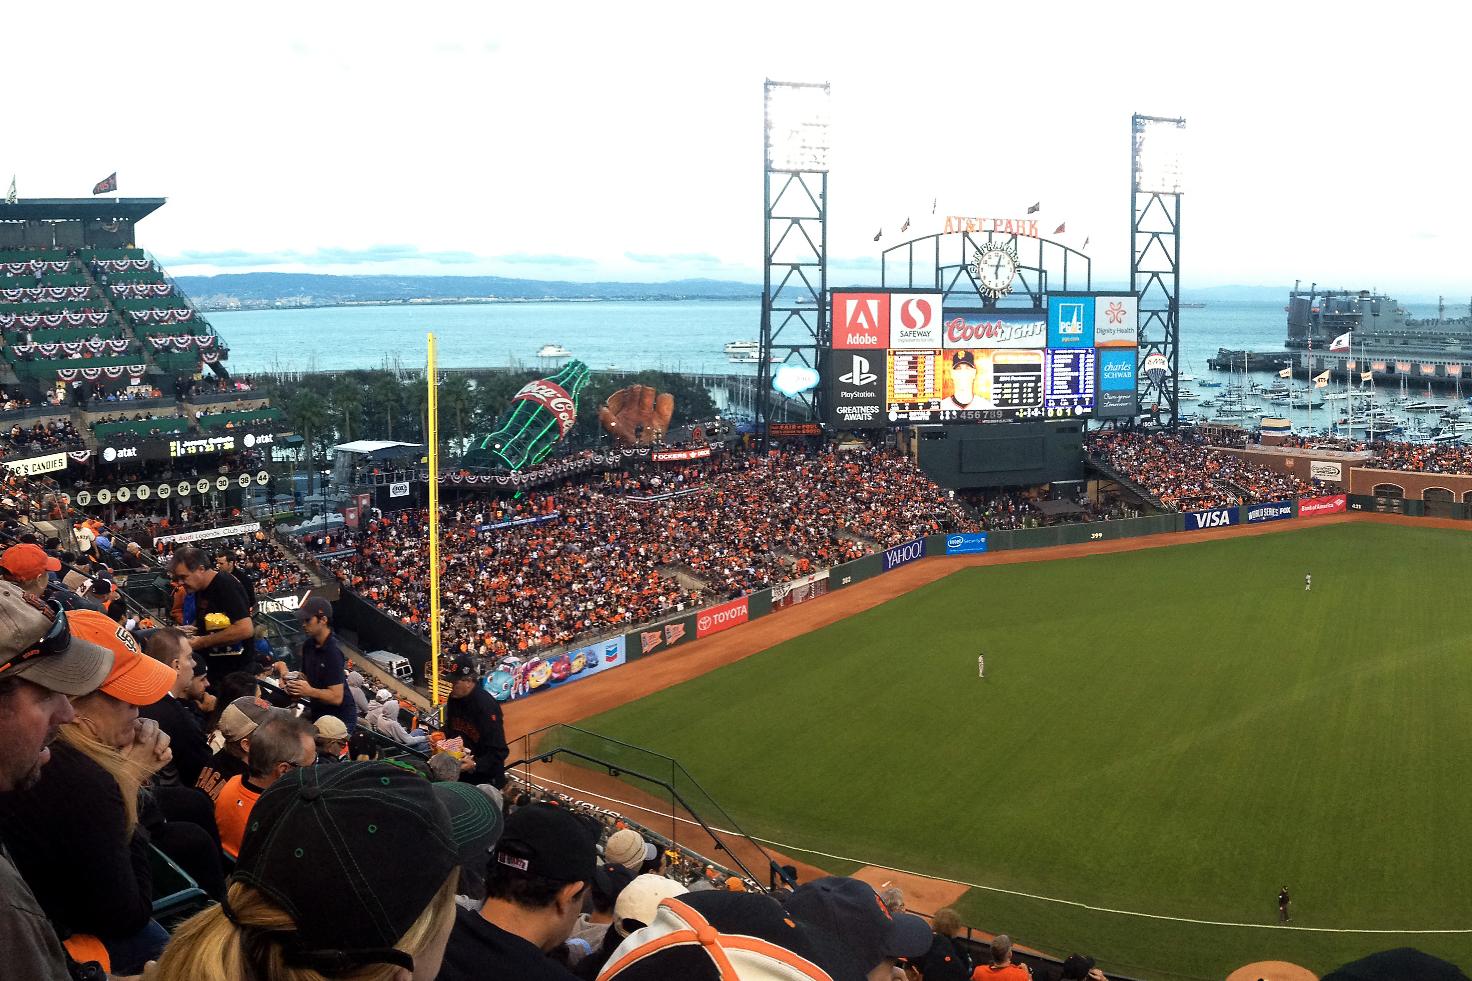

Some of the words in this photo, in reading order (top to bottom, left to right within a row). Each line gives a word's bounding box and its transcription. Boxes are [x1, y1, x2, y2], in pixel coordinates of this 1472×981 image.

[943, 216, 987, 235] AT&T
[993, 218, 1039, 239] PARK
[979, 284, 1014, 299] GIANTS
[900, 330, 932, 338] SAFEWAY
[945, 317, 1004, 342] Coors
[996, 320, 1046, 342] LIGHT
[1096, 327, 1116, 335] Dignity
[846, 333, 878, 345] Adobe
[1103, 361, 1132, 371] charles
[1103, 371, 1132, 379] SCHWAB
[840, 391, 875, 400] PlayStation
[836, 405, 880, 414] GREATNESS
[844, 413, 873, 421] AWAITS
[31, 459, 64, 473] CANDIES
[1316, 502, 1334, 510] America
[1193, 510, 1230, 528] VISA
[1248, 509, 1264, 520] WORLD
[1263, 507, 1279, 517] SERIES
[1279, 506, 1291, 515] FOX
[178, 533, 194, 541] Audi
[222, 527, 238, 535] Club
[886, 540, 923, 568] YAHOO!
[712, 605, 748, 625] TOYOTA
